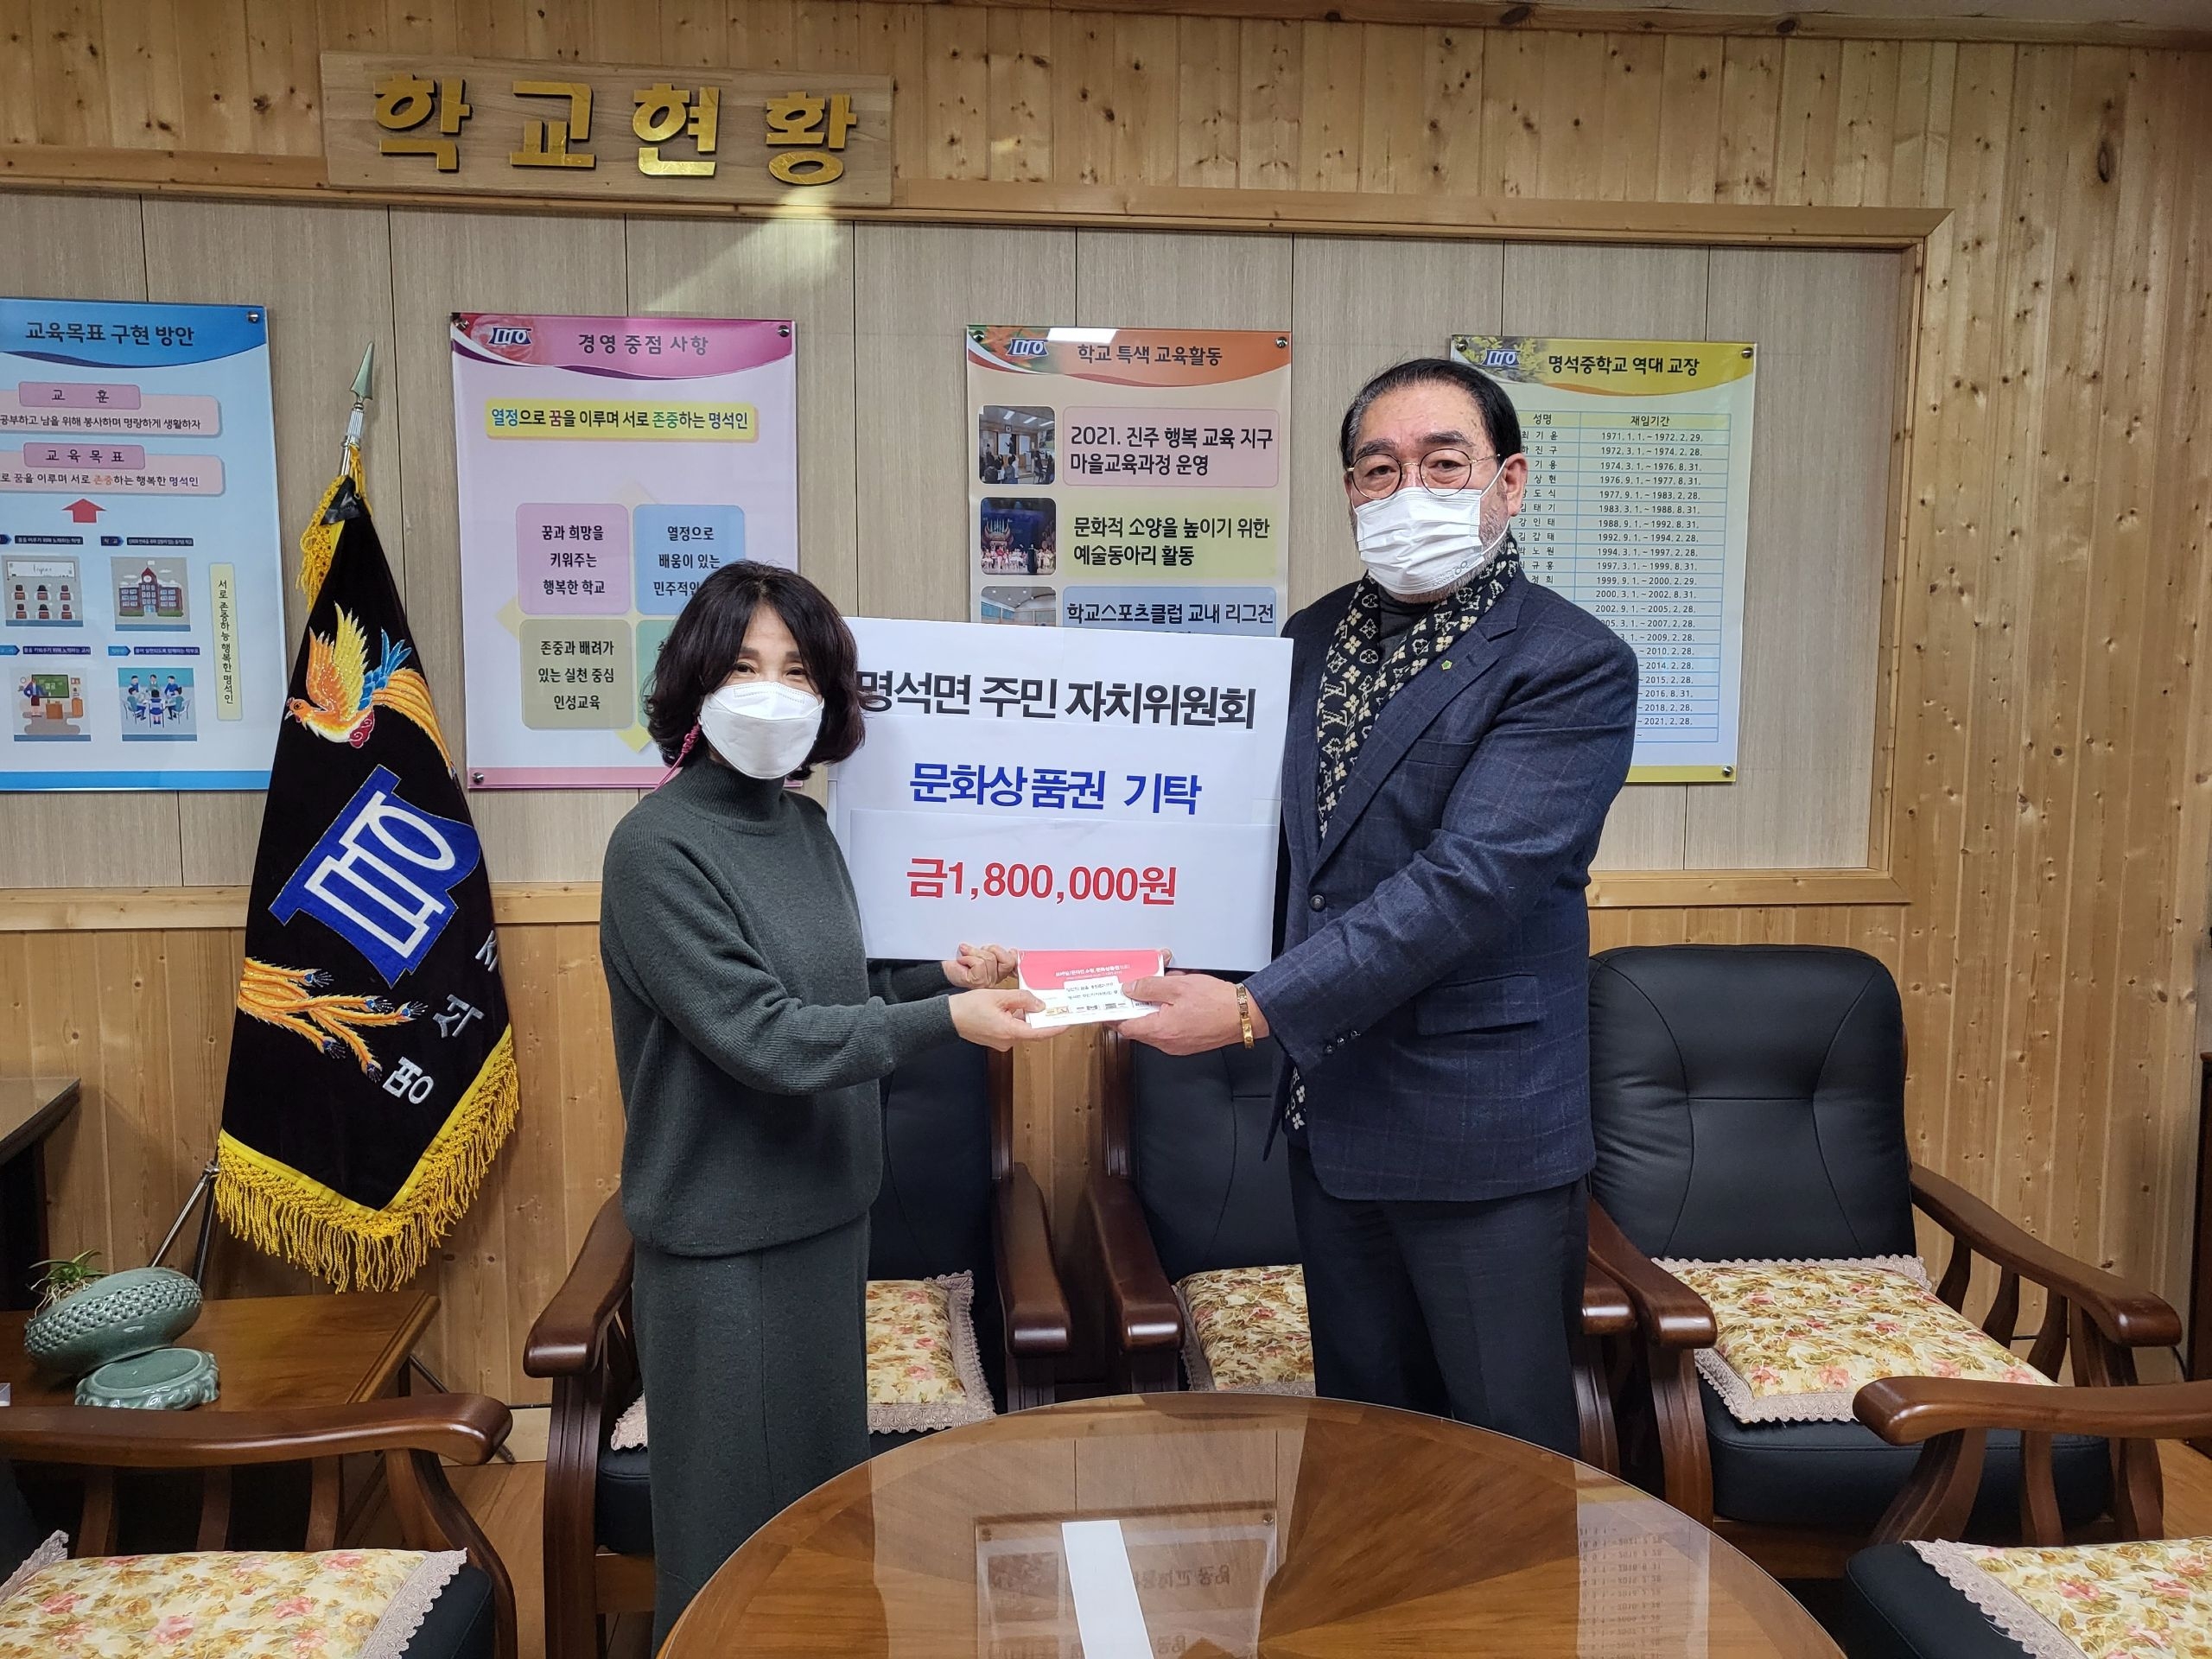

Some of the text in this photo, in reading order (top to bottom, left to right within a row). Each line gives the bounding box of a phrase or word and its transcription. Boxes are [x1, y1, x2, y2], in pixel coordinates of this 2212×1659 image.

[26, 321, 194, 346] 교육목표 구현 방안
[578, 334, 708, 356] 경영 중점 사항
[1078, 344, 1223, 366] 학교 특색 교육활동
[1548, 355, 1700, 377] 명석중학교 역대 교장
[0, 415, 200, 429] 공부하고 남을 위해 봉사하며 명랑하게 생활하자
[492, 409, 748, 430] 열정으로 꿈을 이루며 서로 존중하는 명석인
[1534, 414, 1669, 426] 성명 재임기간
[1071, 426, 1273, 450] 2021. 진주 행복 교육 지구
[1071, 454, 1209, 475] 마을교육과정 운영
[14, 474, 34, 483] 꿈을
[37, 474, 67, 485] 이루며
[71, 474, 91, 485] 서로
[137, 476, 166, 486] 행복한
[169, 477, 198, 487] 명석인
[542, 525, 604, 541] 꿈과 희망을
[667, 526, 715, 541] 열정으로
[1074, 517, 1270, 538] 문화적 소양을 높이기 위한
[550, 553, 597, 568] 키워주는
[658, 553, 720, 569] 배움이 있는
[1074, 545, 1194, 566] 예술동아리 활동
[543, 580, 605, 594] 행복한 학교
[1067, 603, 1274, 624] 학교스포츠클럽 교내 리그전
[541, 641, 614, 656] 존중과 배려가
[538, 668, 614, 683] 있는 실천 중심
[555, 695, 600, 710] 인성교육
[857, 671, 1256, 729] 명석면 주민 자치위원회
[909, 762, 1202, 816] 문화상품권 기탁
[906, 857, 1177, 906] 금1,800,000원
